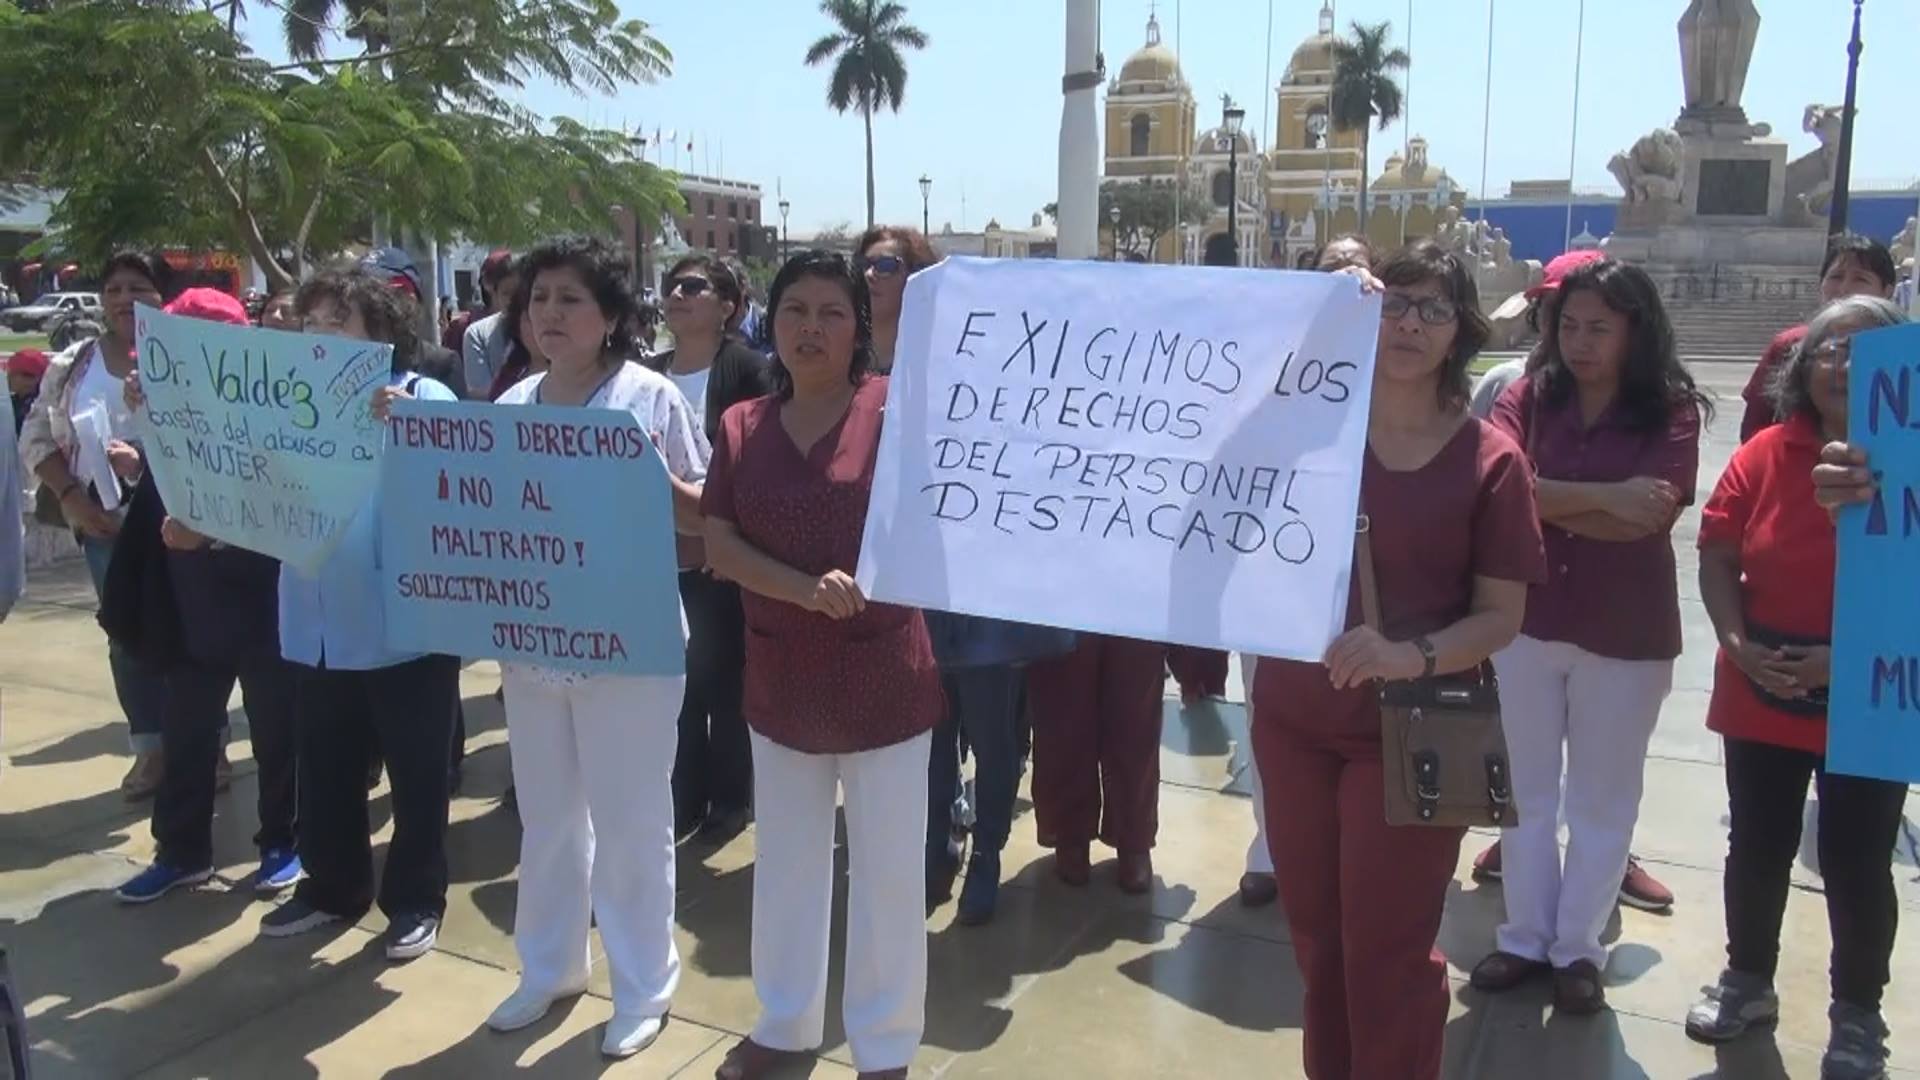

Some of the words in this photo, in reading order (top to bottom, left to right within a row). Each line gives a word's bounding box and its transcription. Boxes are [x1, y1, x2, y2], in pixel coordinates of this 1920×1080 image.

[145, 336, 191, 388] Dr.
[955, 311, 1242, 394] EXIGIMOS
[1275, 351, 1358, 402] LOS
[143, 393, 212, 437] basta
[223, 412, 252, 447] del
[264, 426, 337, 459] abuso
[351, 444, 374, 461] a
[946, 381, 1209, 439] DERECHOS
[157, 435, 178, 460] la
[388, 415, 495, 453] TENEMOS
[516, 421, 645, 460] DERECHOS
[521, 479, 553, 512] AL
[934, 437, 1012, 479] DEL
[1034, 443, 1300, 515] PERSONAL
[241, 500, 264, 530] AL
[920, 481, 1315, 565] DESTACADO
[398, 573, 552, 611] SOLICITAMOS
[492, 623, 628, 662] JUSTICIA
